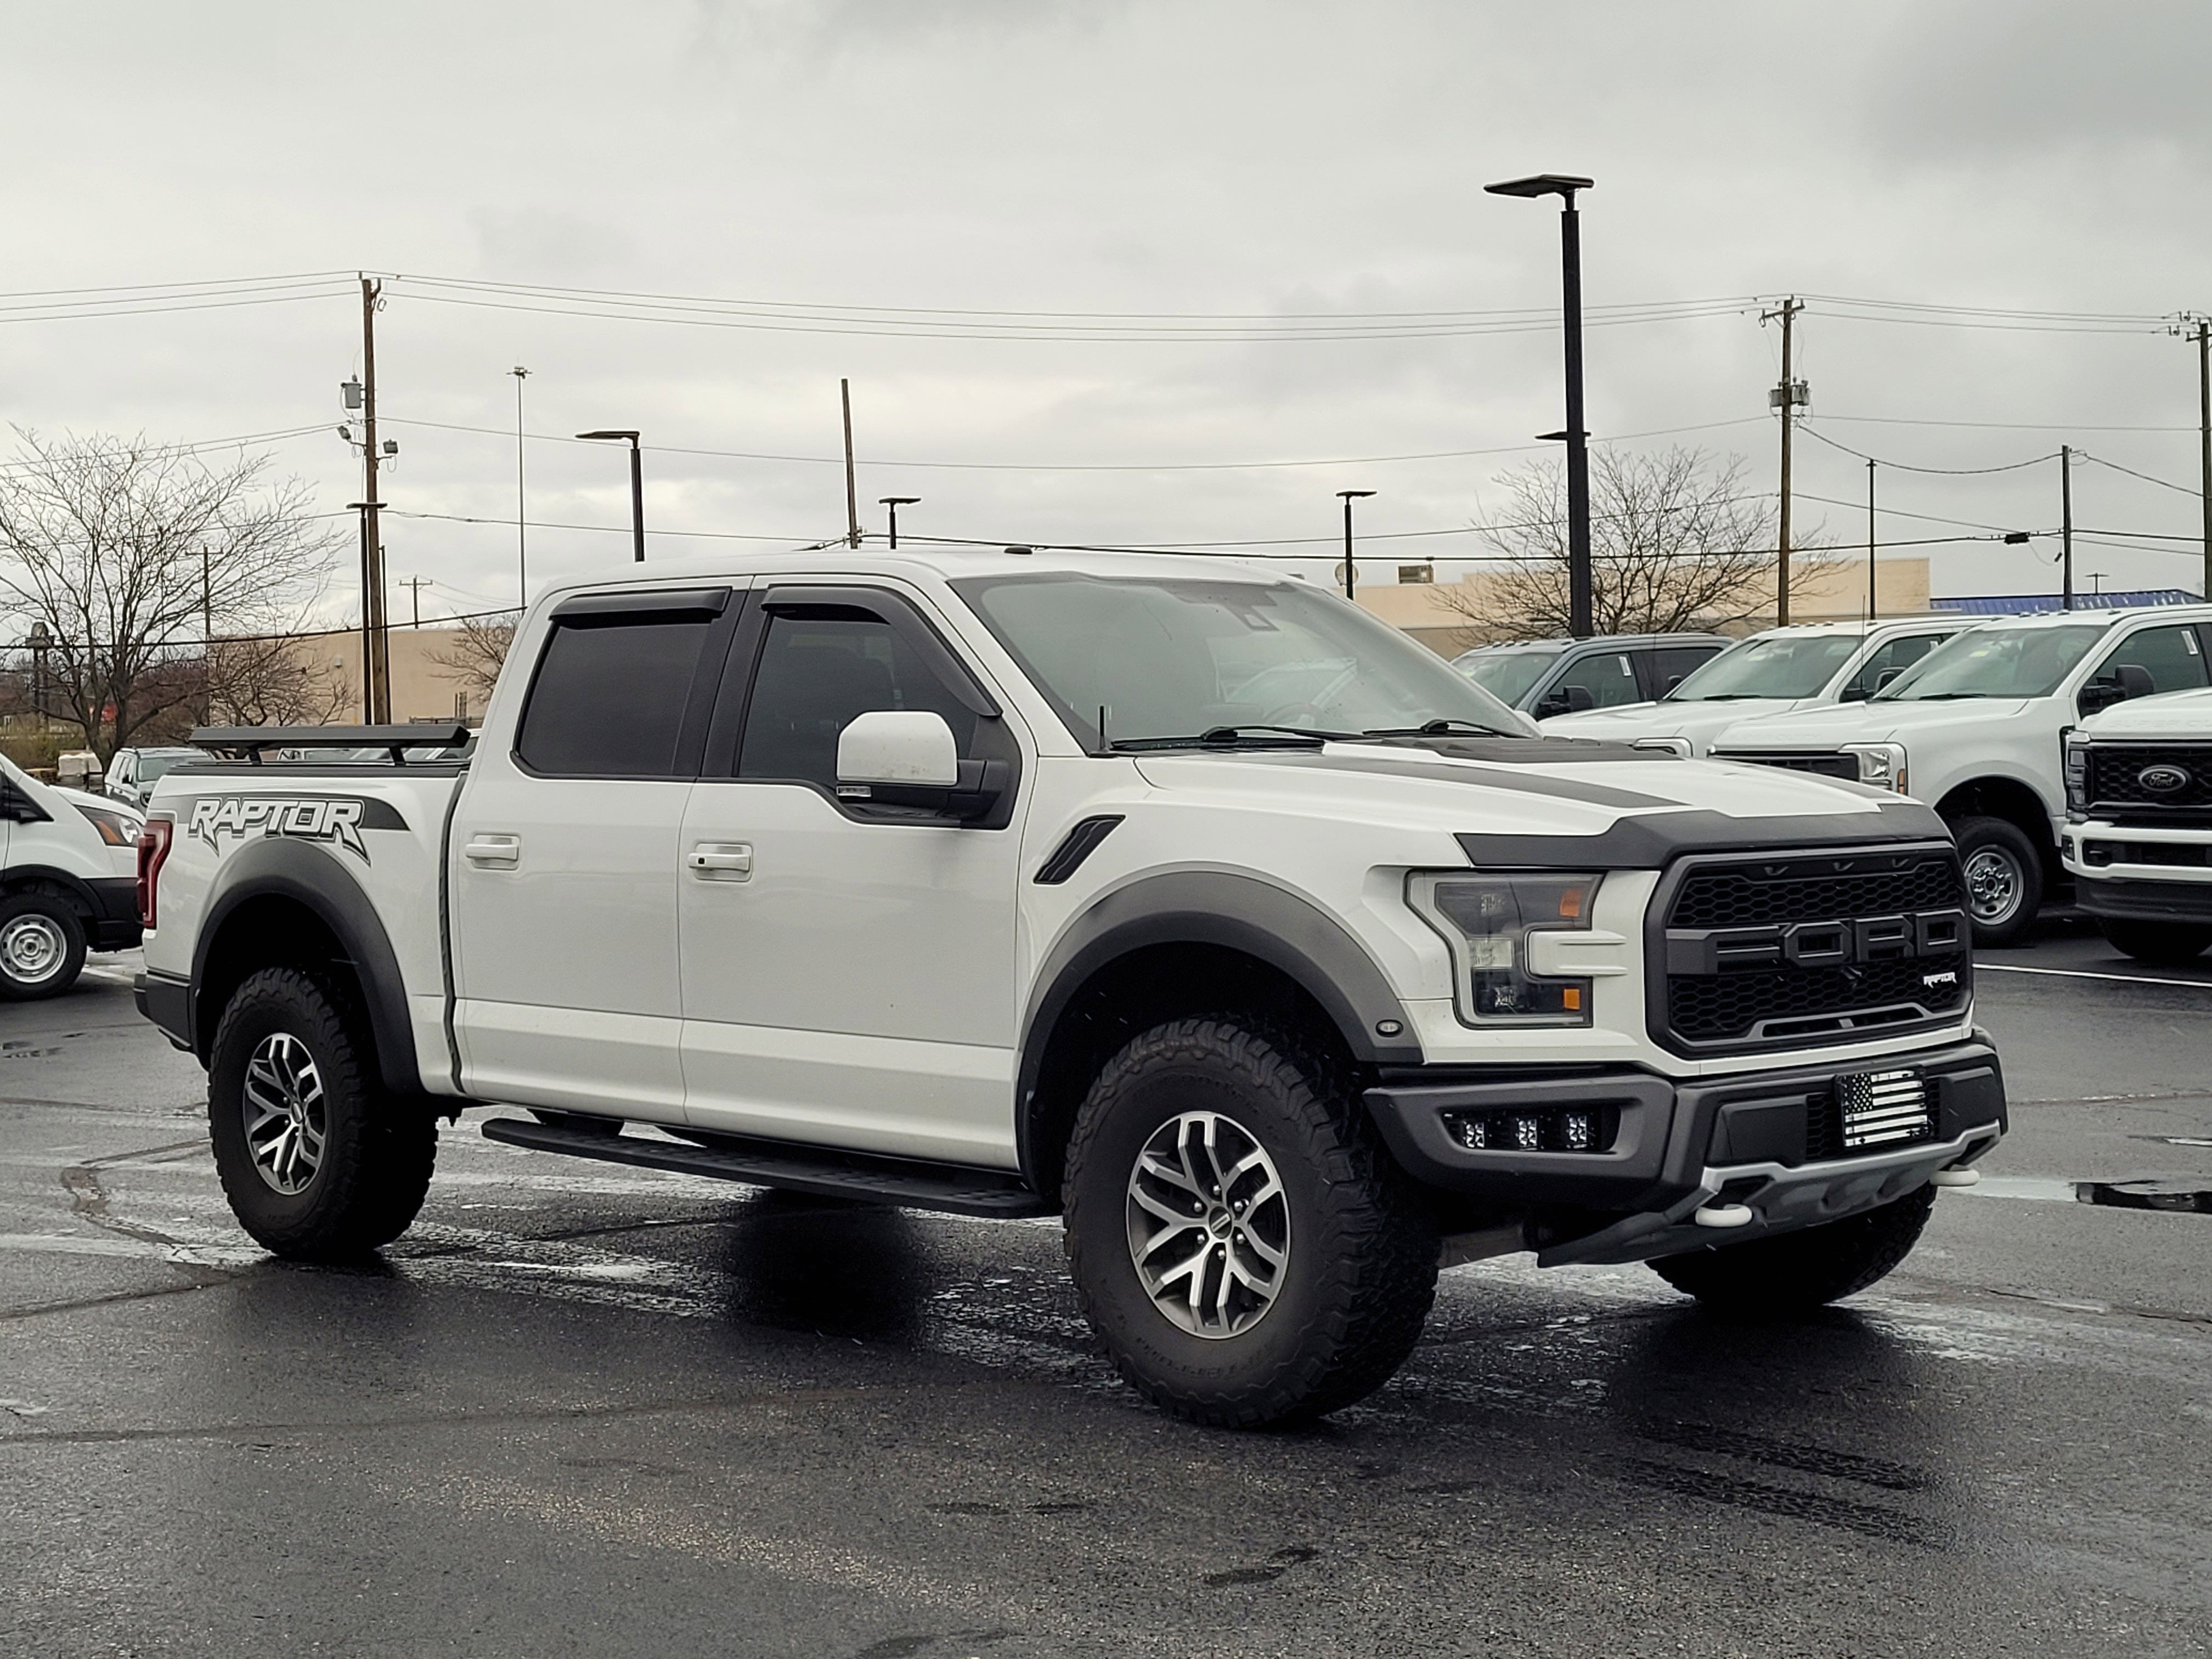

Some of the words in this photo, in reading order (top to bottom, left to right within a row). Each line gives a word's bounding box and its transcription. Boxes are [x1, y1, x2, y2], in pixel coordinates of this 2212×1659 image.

[2149, 773, 2174, 786] Ford
[188, 798, 371, 867] RAPTOR
[1703, 909, 1966, 973] FORD
[1923, 972, 1957, 989] RAPTOR
